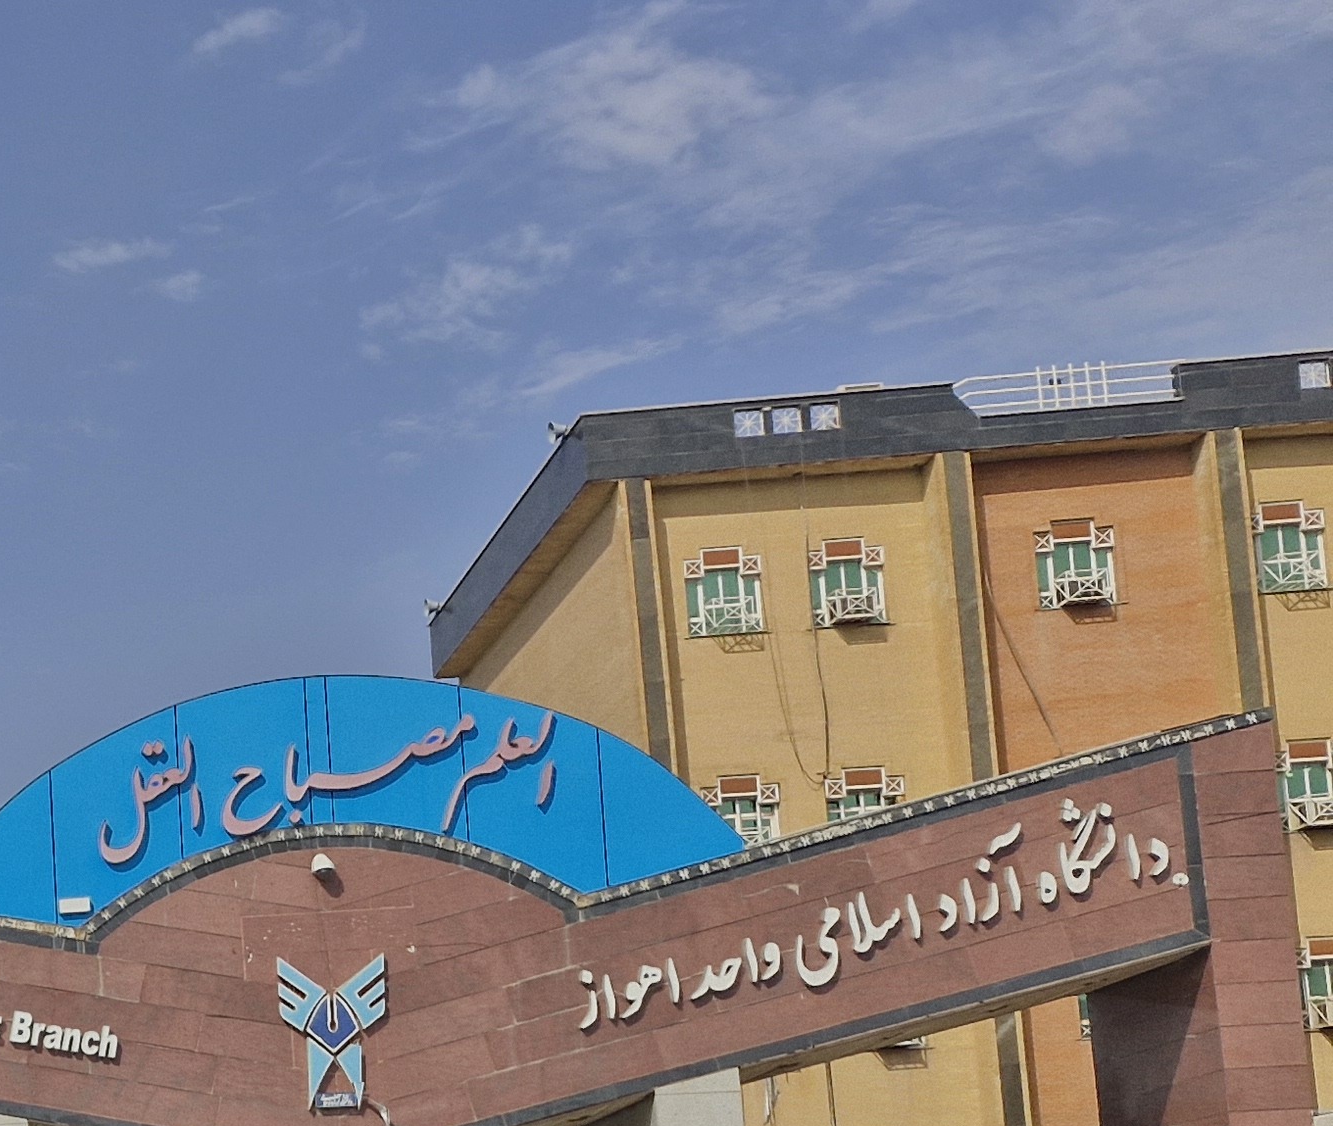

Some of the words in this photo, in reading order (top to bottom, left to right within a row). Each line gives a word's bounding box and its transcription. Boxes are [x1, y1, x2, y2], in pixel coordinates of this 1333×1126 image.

[98, 735, 202, 864] العقل
[220, 713, 475, 836] مصباح
[442, 709, 556, 832] العلم
[938, 822, 1022, 933] آزاد
[1036, 798, 1171, 905] دانشگاه
[579, 956, 680, 1030] اهواز
[690, 937, 780, 1001] واحد
[795, 891, 923, 988] اسلامی
[9, 1010, 120, 1060] Branch
